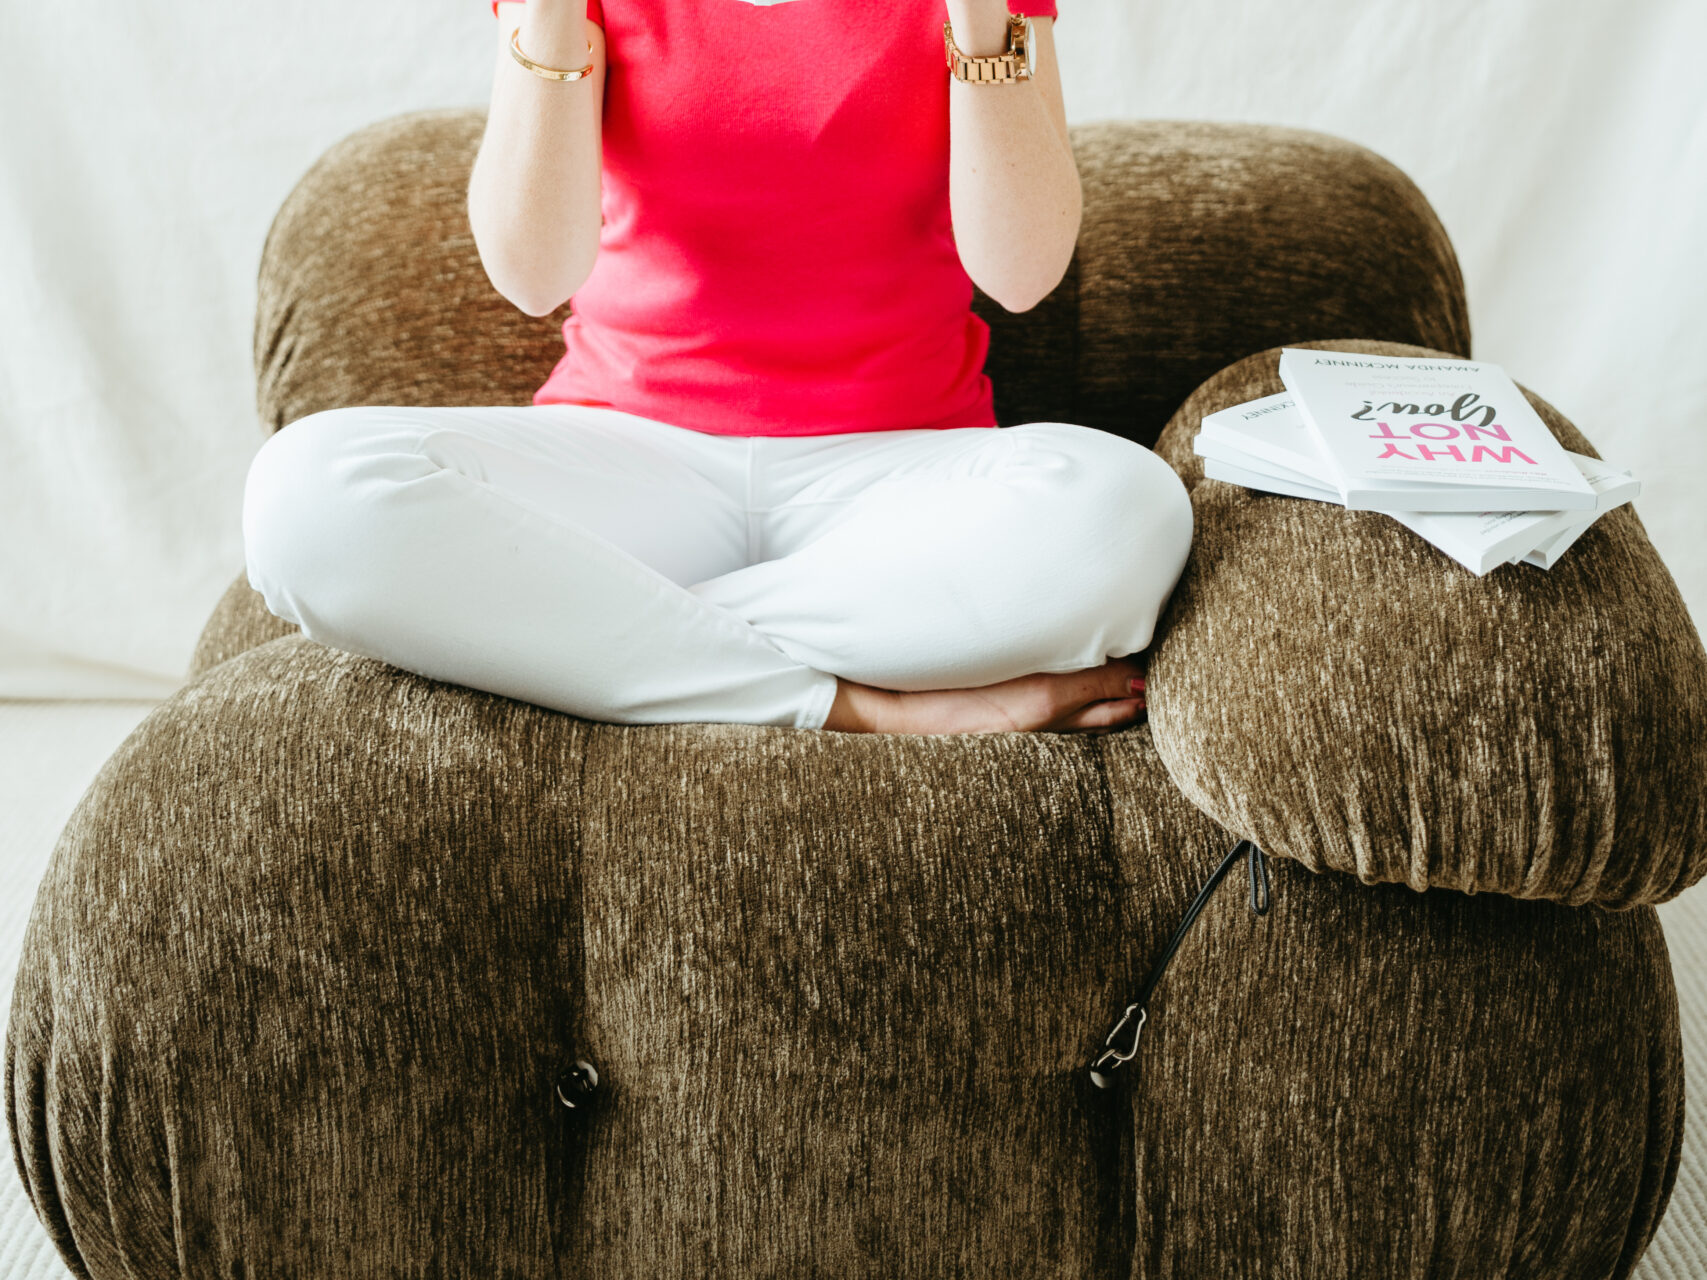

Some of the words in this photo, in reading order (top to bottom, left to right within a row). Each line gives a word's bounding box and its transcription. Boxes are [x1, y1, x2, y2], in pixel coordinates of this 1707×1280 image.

[1315, 358, 1400, 370] MCKINNEY
[1404, 364, 1480, 372] AMANDA
[1350, 393, 1496, 427] You?
[1368, 422, 1512, 442] NOT
[1376, 443, 1539, 465] WHY
